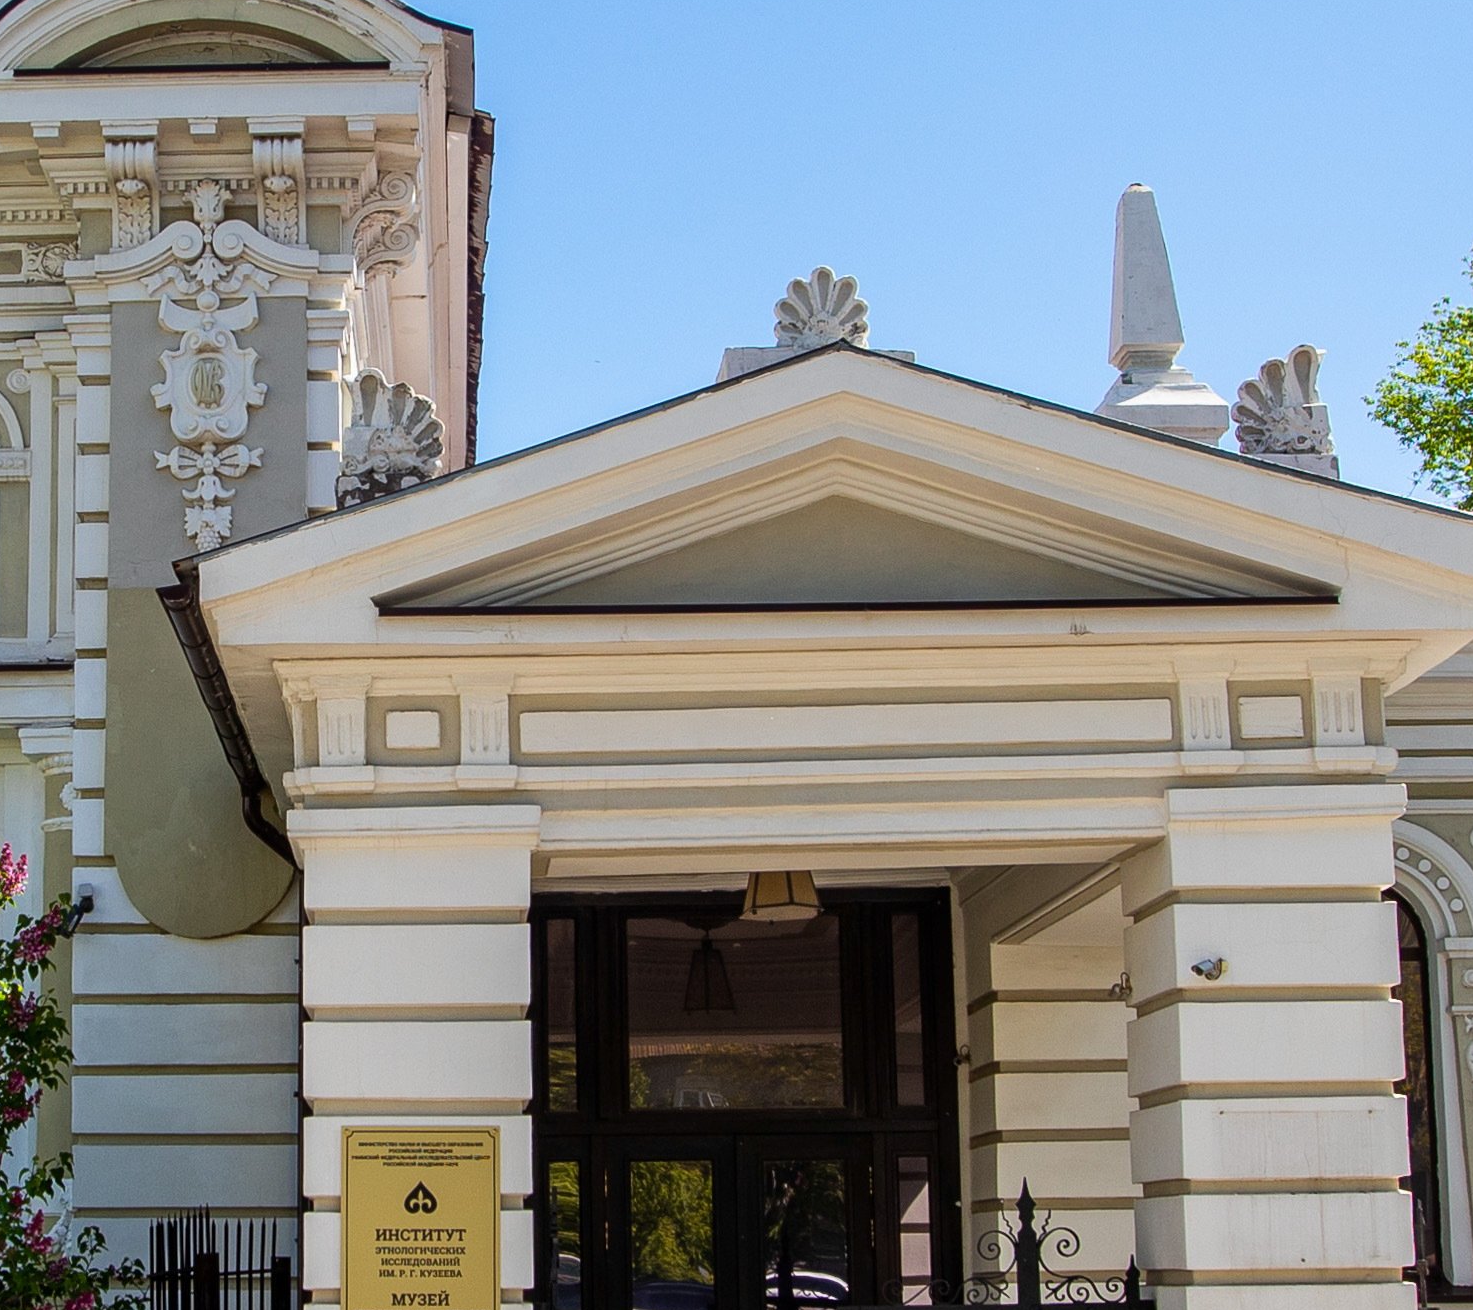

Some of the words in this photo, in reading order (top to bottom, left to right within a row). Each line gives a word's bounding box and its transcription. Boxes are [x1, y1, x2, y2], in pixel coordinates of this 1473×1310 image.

[375, 1228, 467, 1241] ИНСТИТУТ
[375, 1247, 466, 1255] ЭТНОЛОГИЧЕСКИХ
[381, 1257, 460, 1267] ИССЛЕДОВАНИЙ
[379, 1270, 397, 1278] ИМ.
[399, 1270, 407, 1278] Р.
[410, 1270, 417, 1278] Г.
[420, 1270, 462, 1278] КУЗЕЕВА
[391, 1291, 450, 1306] МУЗЕЙ
